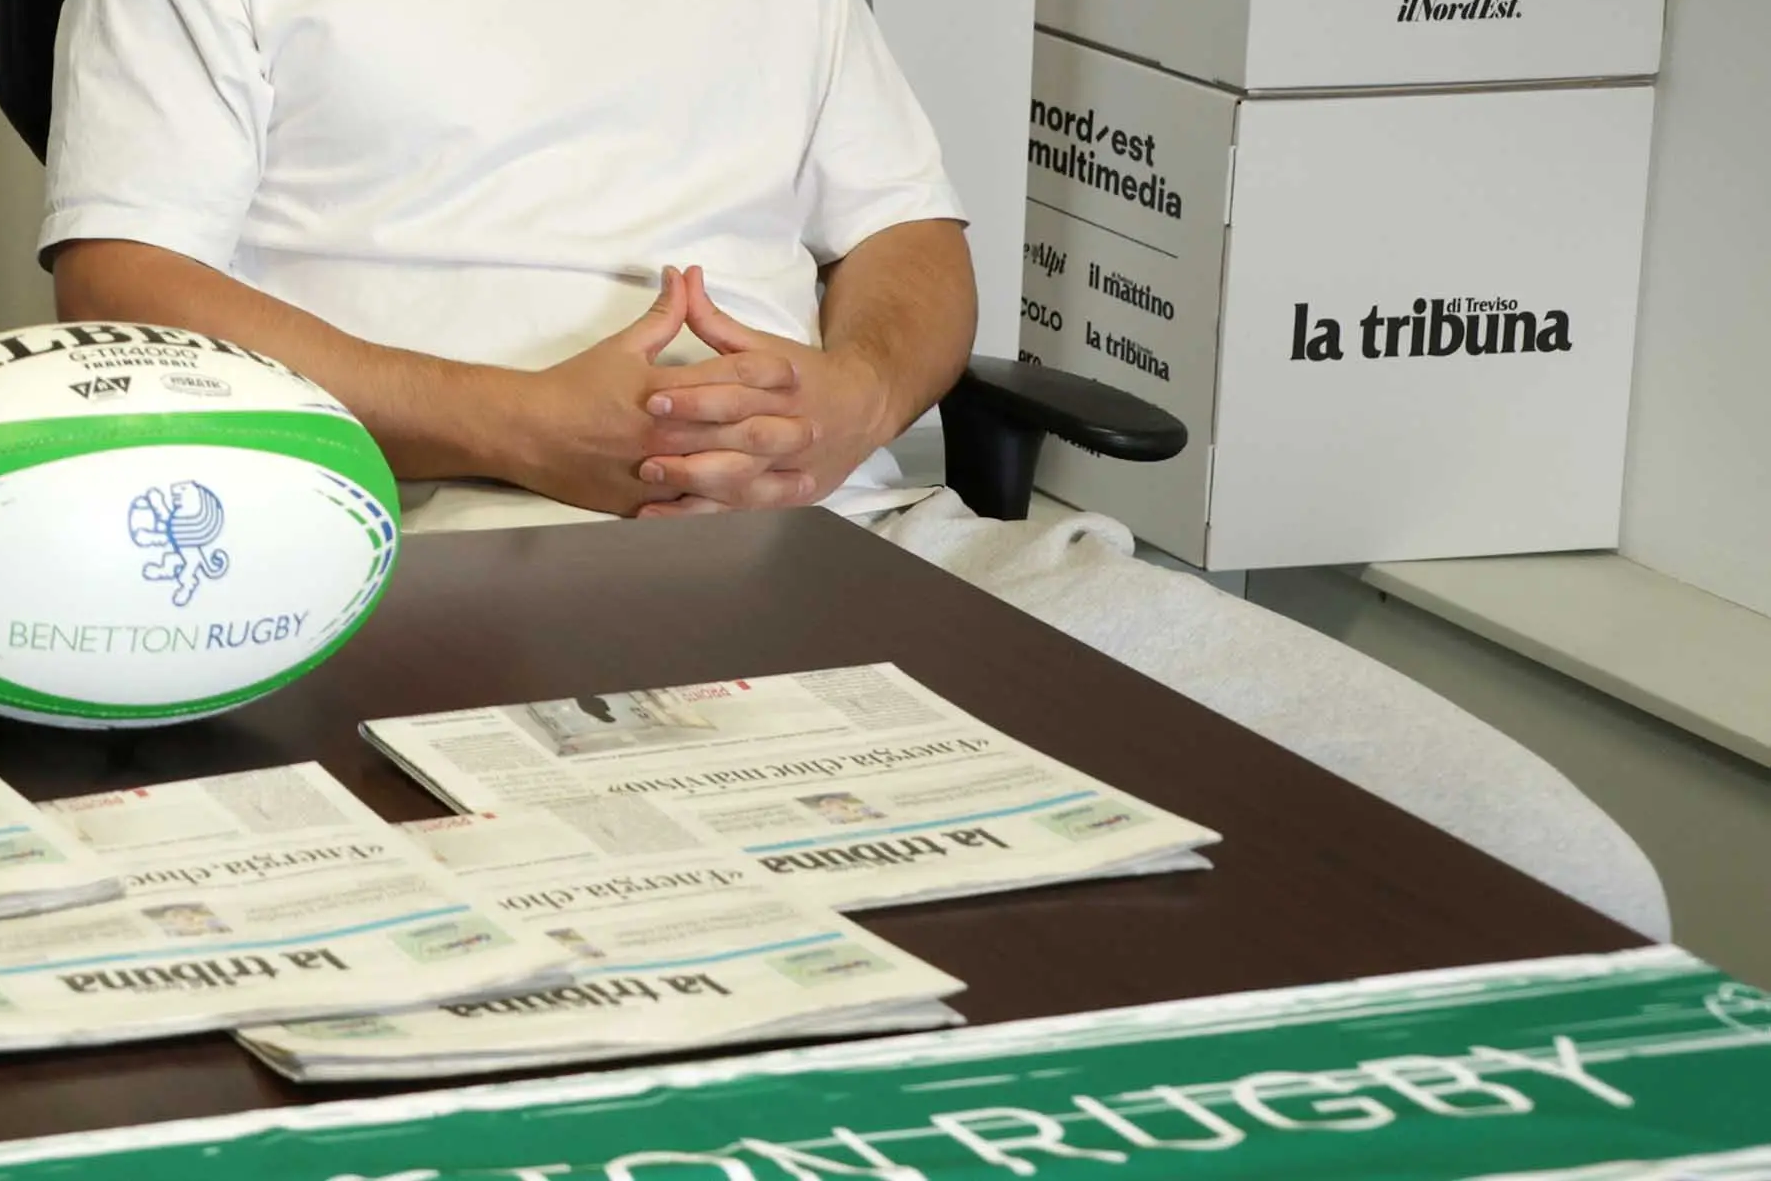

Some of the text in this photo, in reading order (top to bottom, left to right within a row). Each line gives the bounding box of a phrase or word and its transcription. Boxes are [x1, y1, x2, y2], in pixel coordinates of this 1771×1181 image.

[1028, 138, 1182, 219] multimedia
[1089, 263, 1100, 290] il
[1104, 274, 1175, 321] mattino
[1446, 297, 1519, 314] di Treviso
[1086, 321, 1170, 381] la tribuna
[1290, 297, 1573, 362] la tribuna
[9, 611, 310, 654] BENETTON RUGBY
[758, 827, 1010, 874] la tribuna
[57, 947, 351, 993] la tribuna
[660, 973, 732, 997] la
[930, 1035, 1634, 1175] RUGBY
